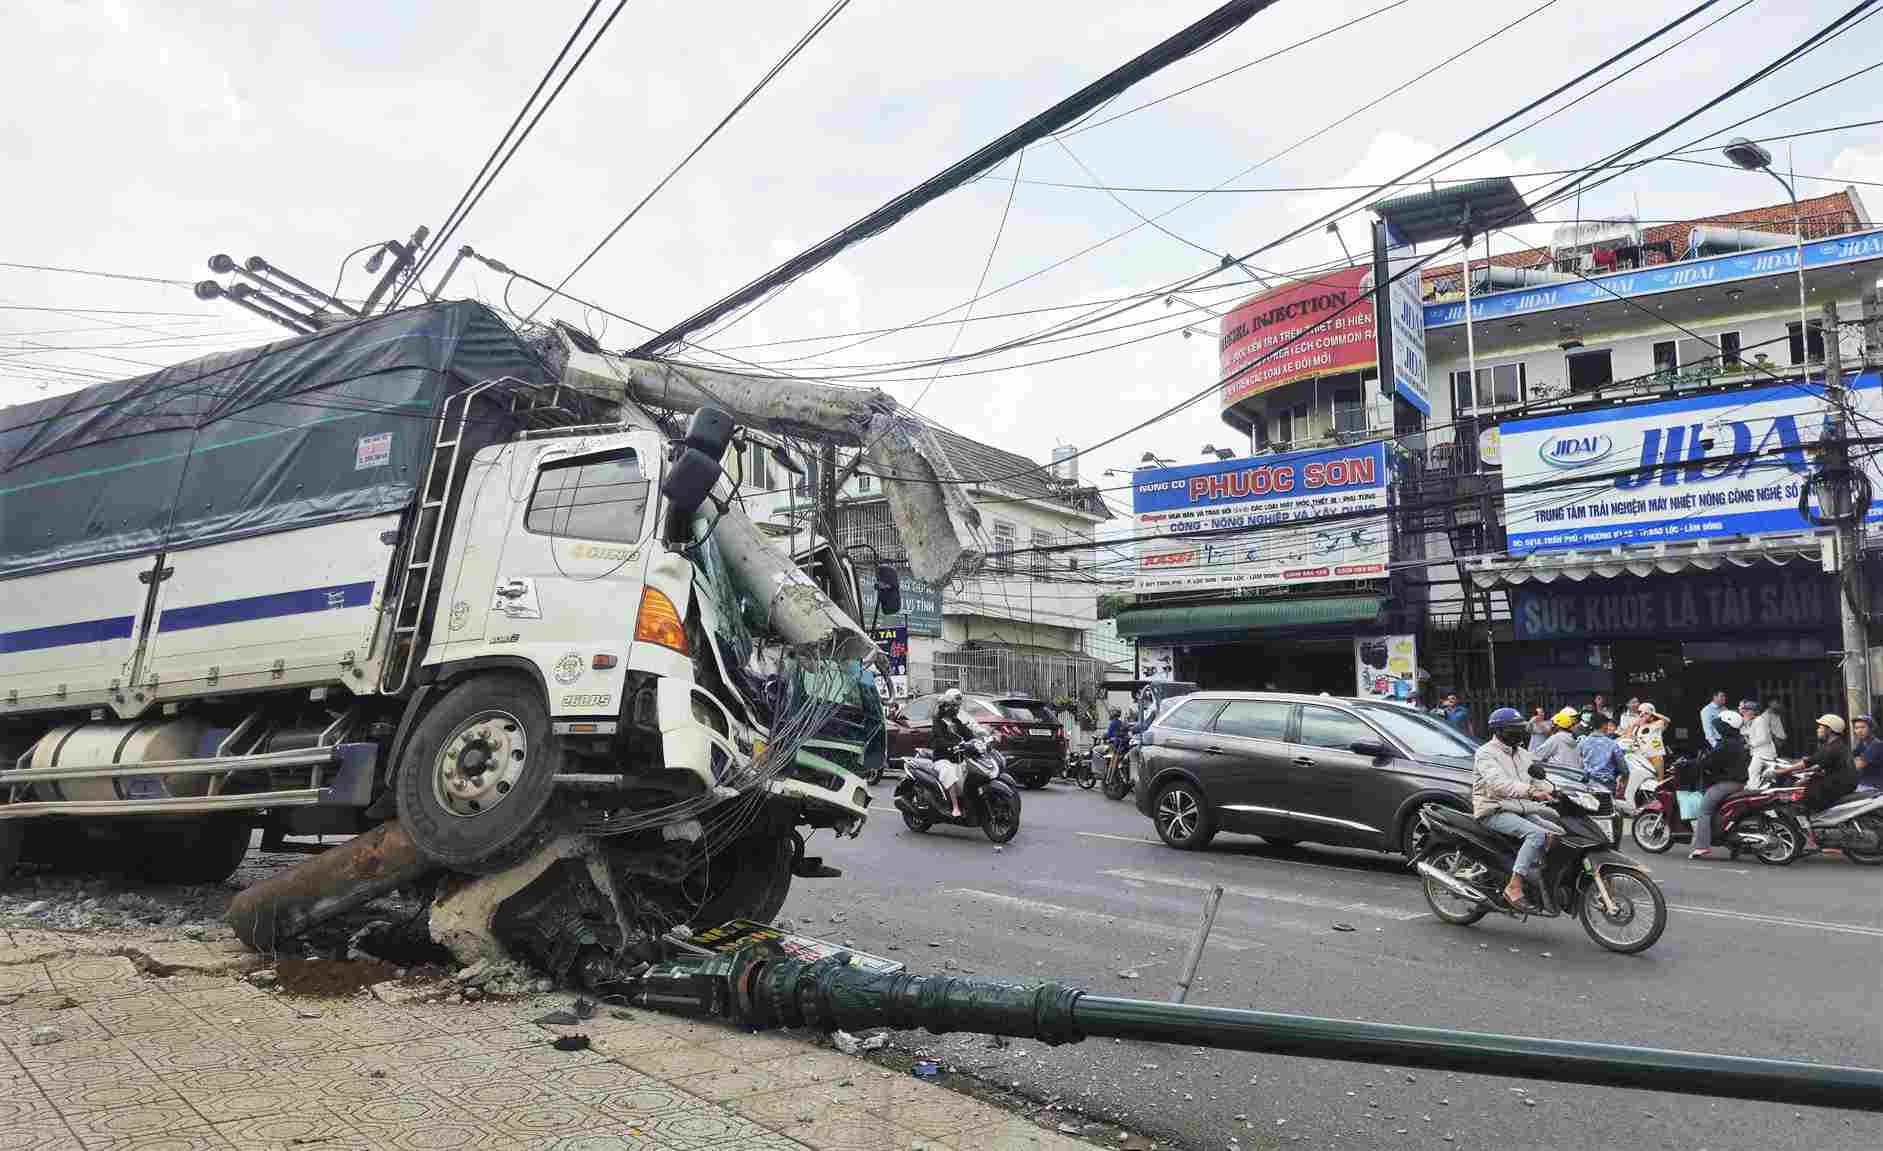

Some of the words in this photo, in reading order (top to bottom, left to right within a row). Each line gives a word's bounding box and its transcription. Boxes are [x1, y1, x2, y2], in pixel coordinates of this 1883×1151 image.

[1669, 265, 1714, 284] JIDAI
[1516, 290, 1560, 310] JIDAI
[1252, 290, 1347, 334] INJECTION
[1445, 303, 1486, 321] JIAI
[1315, 331, 1362, 349] COMMON
[1551, 436, 1598, 457] JIDAI
[1188, 462, 1295, 500] PHƯỚC
[1303, 455, 1376, 490] SƠN
[1535, 508, 1565, 523] TRUNG
[1567, 504, 1586, 520] TÂM
[1649, 494, 1668, 512] MÁY
[1784, 481, 1799, 499] SỐ
[1169, 518, 1201, 533] CÔNG
